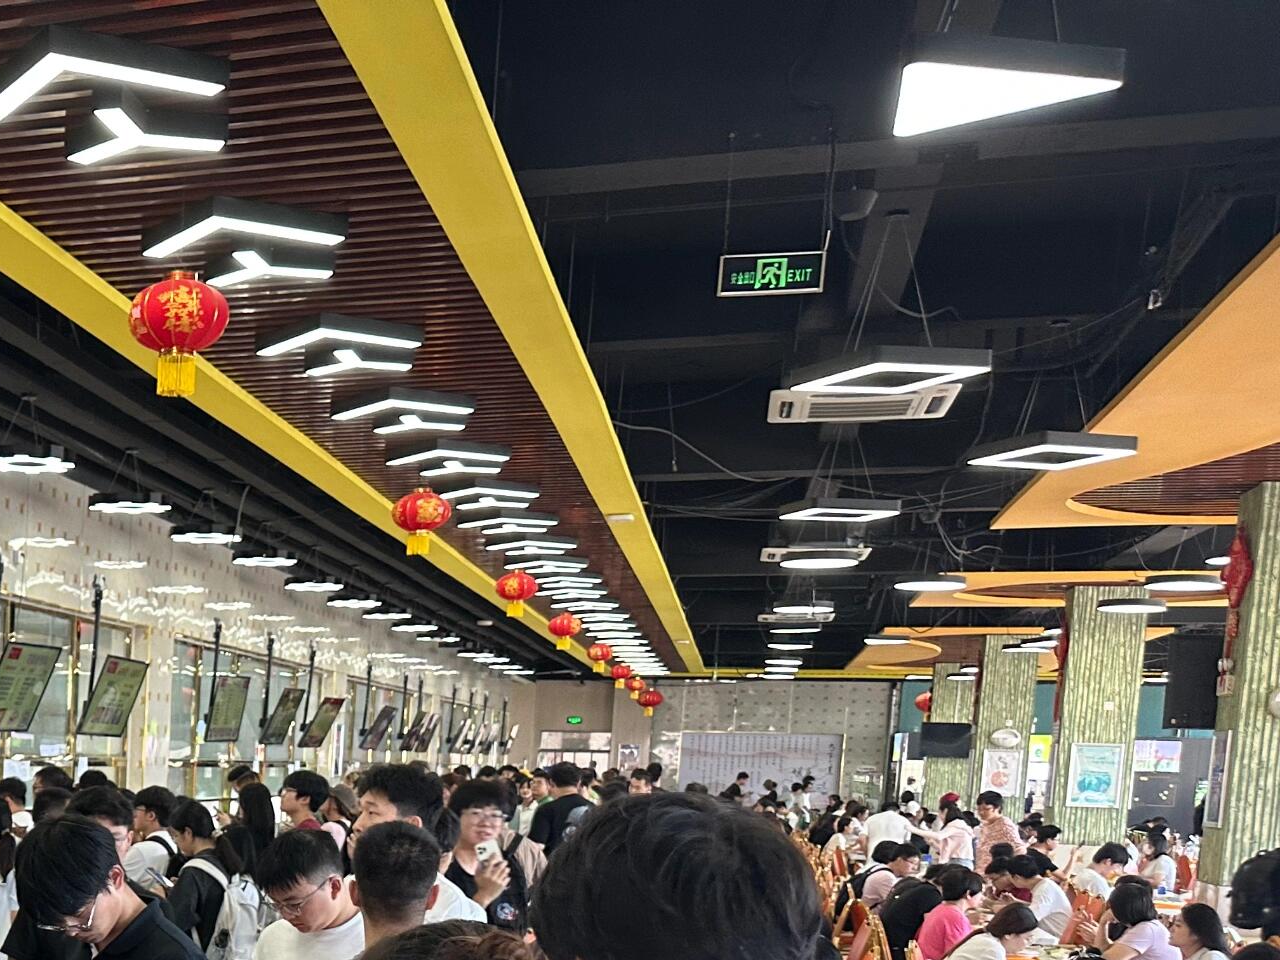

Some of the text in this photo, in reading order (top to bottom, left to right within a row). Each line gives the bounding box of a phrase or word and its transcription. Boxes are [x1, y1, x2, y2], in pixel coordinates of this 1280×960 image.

[729, 271, 756, 285] 安全出口
[787, 268, 813, 283] EXIT
